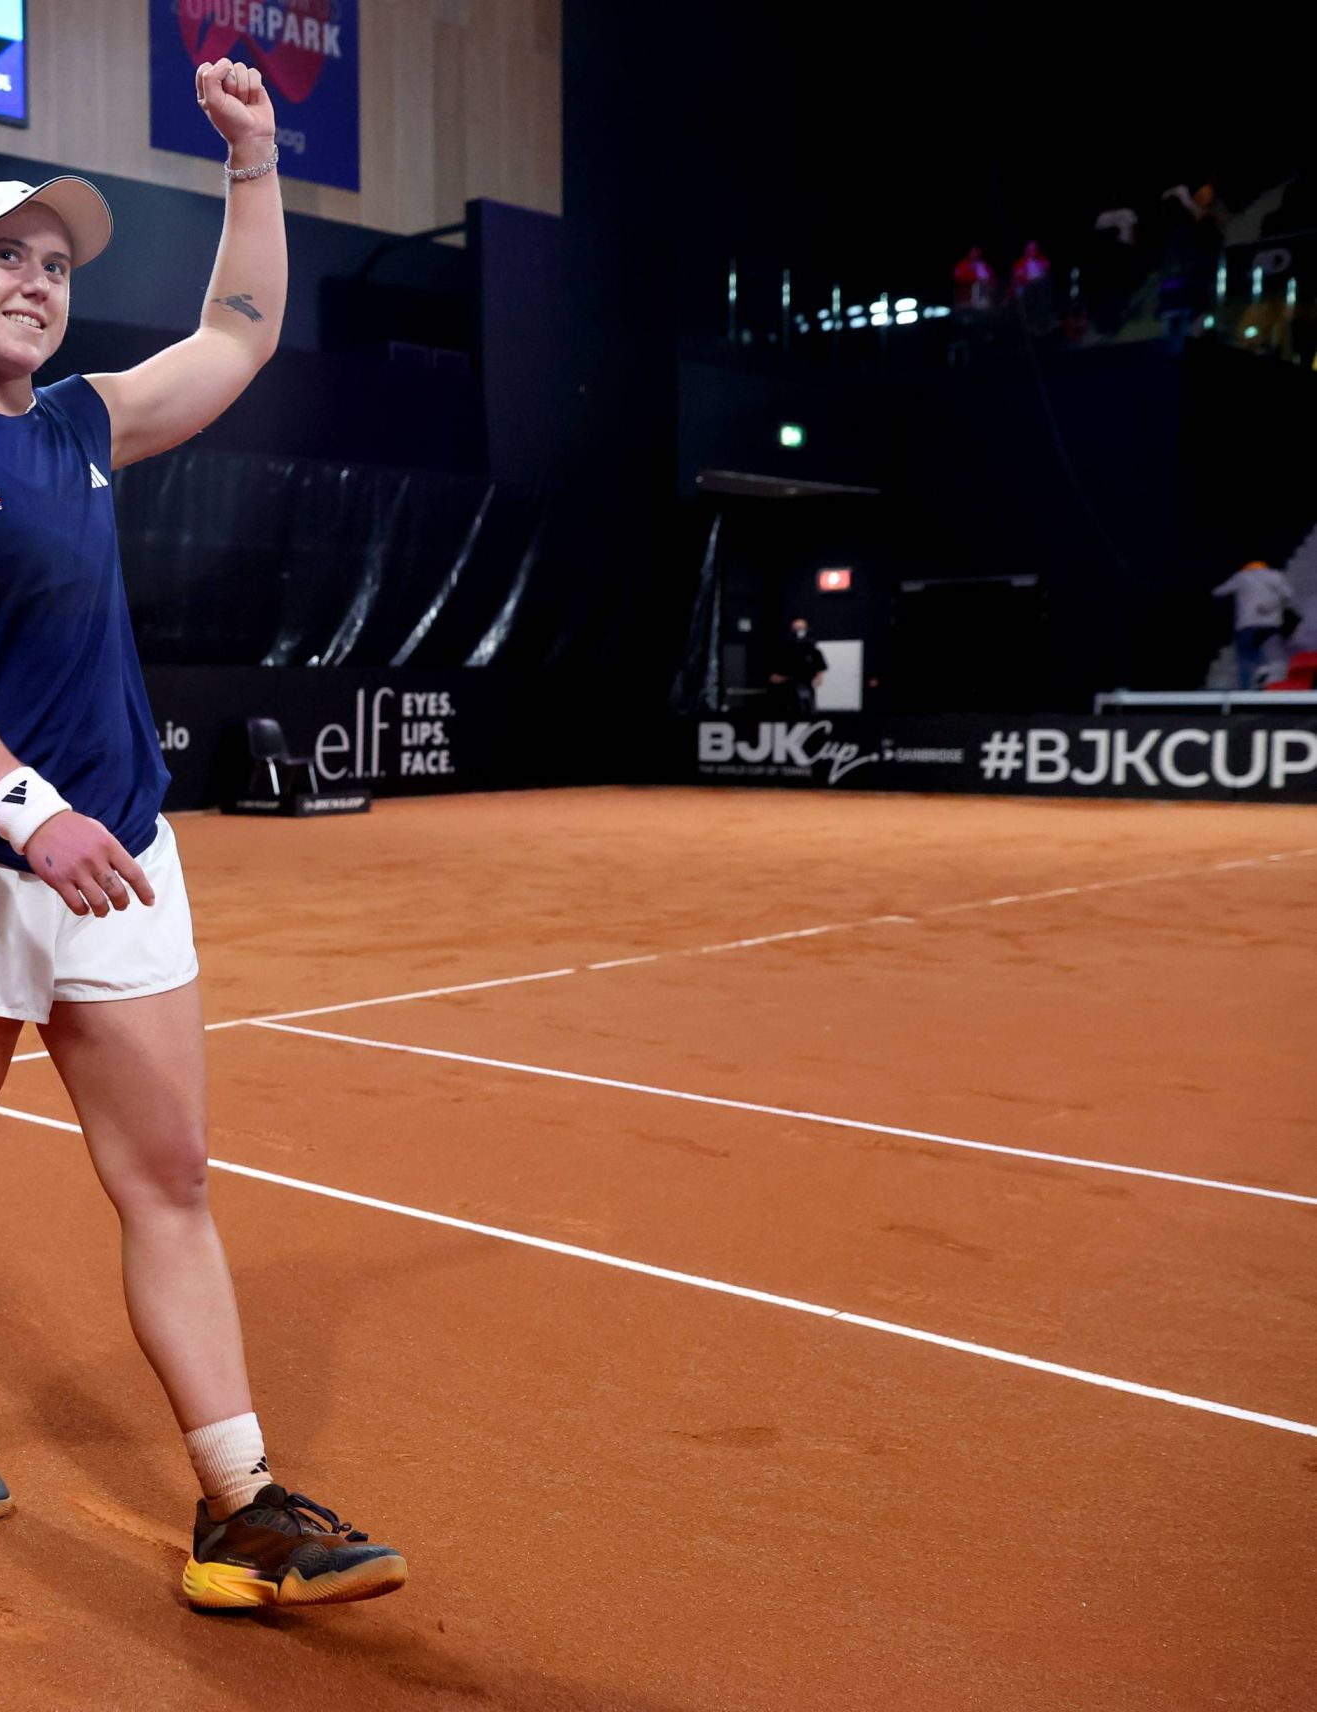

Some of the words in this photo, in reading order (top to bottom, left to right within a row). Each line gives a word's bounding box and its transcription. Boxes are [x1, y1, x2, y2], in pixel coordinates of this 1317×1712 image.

[402, 691, 456, 717] EYES.
[155, 720, 190, 750] .io
[401, 720, 450, 747] LIPS.
[400, 749, 455, 776] FACE.
[980, 728, 1317, 789] #BJKCUP
